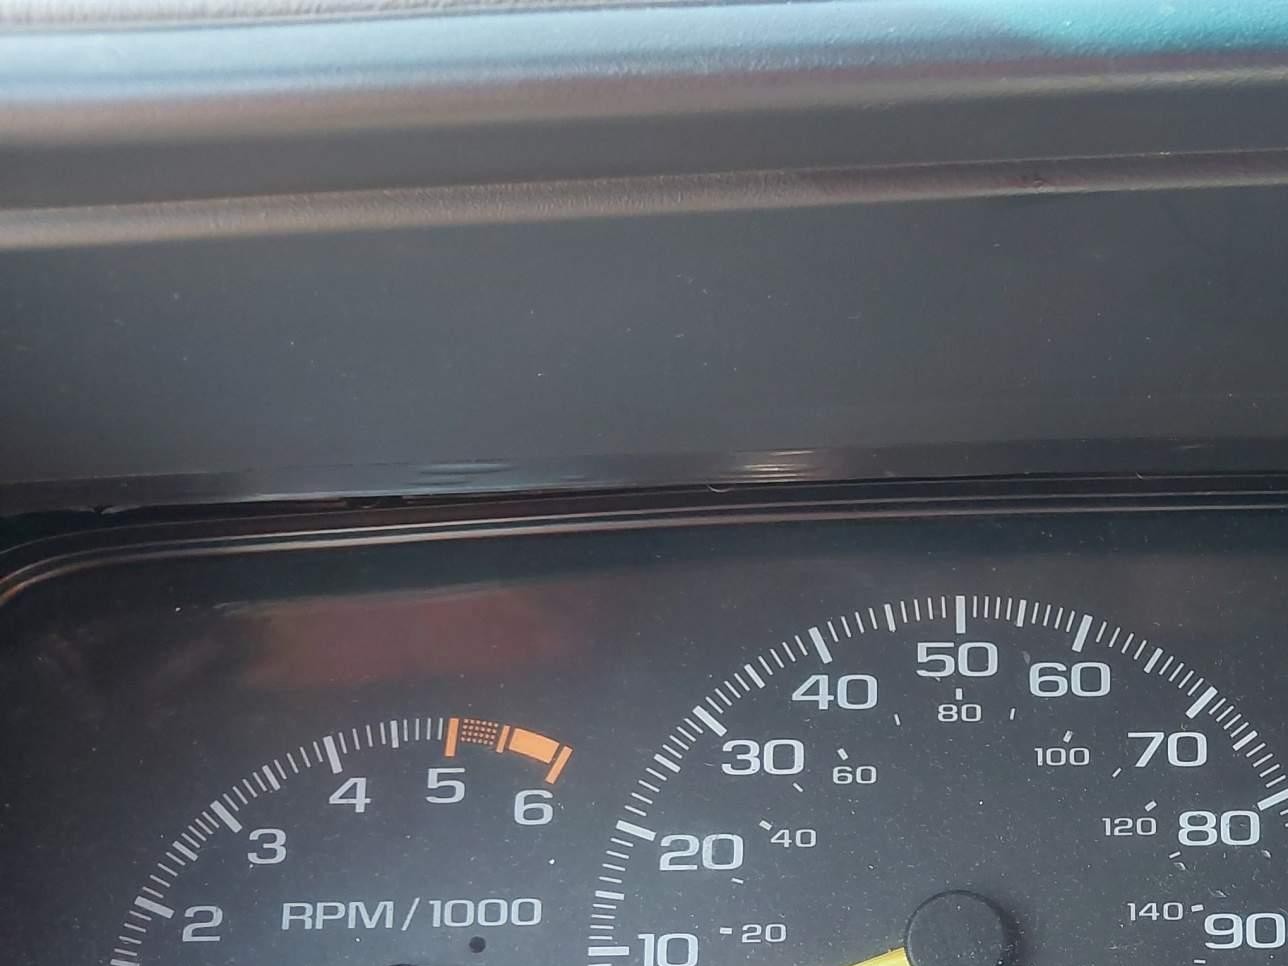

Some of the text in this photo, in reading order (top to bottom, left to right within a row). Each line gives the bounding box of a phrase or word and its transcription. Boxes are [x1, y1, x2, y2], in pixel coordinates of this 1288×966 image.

[917, 643, 997, 676] 50
[792, 675, 877, 709] 40
[1030, 663, 1110, 696] 60
[938, 704, 981, 721] 80
[722, 740, 804, 775] 30
[1035, 748, 1089, 765] 100
[1128, 732, 1206, 767] 70
[427, 768, 465, 803] 5
[833, 766, 876, 784] 60
[329, 778, 371, 812] 4
[515, 790, 552, 825] 6
[771, 830, 816, 847] 40
[1103, 818, 1156, 835] 120
[1178, 810, 1261, 846] 80
[248, 829, 286, 864] 3
[660, 834, 743, 870] 20
[183, 906, 222, 941] 2
[282, 898, 541, 930] RPM/1000
[1128, 903, 1183, 920] 140
[742, 924, 786, 942] 20
[1205, 913, 1285, 948] 90
